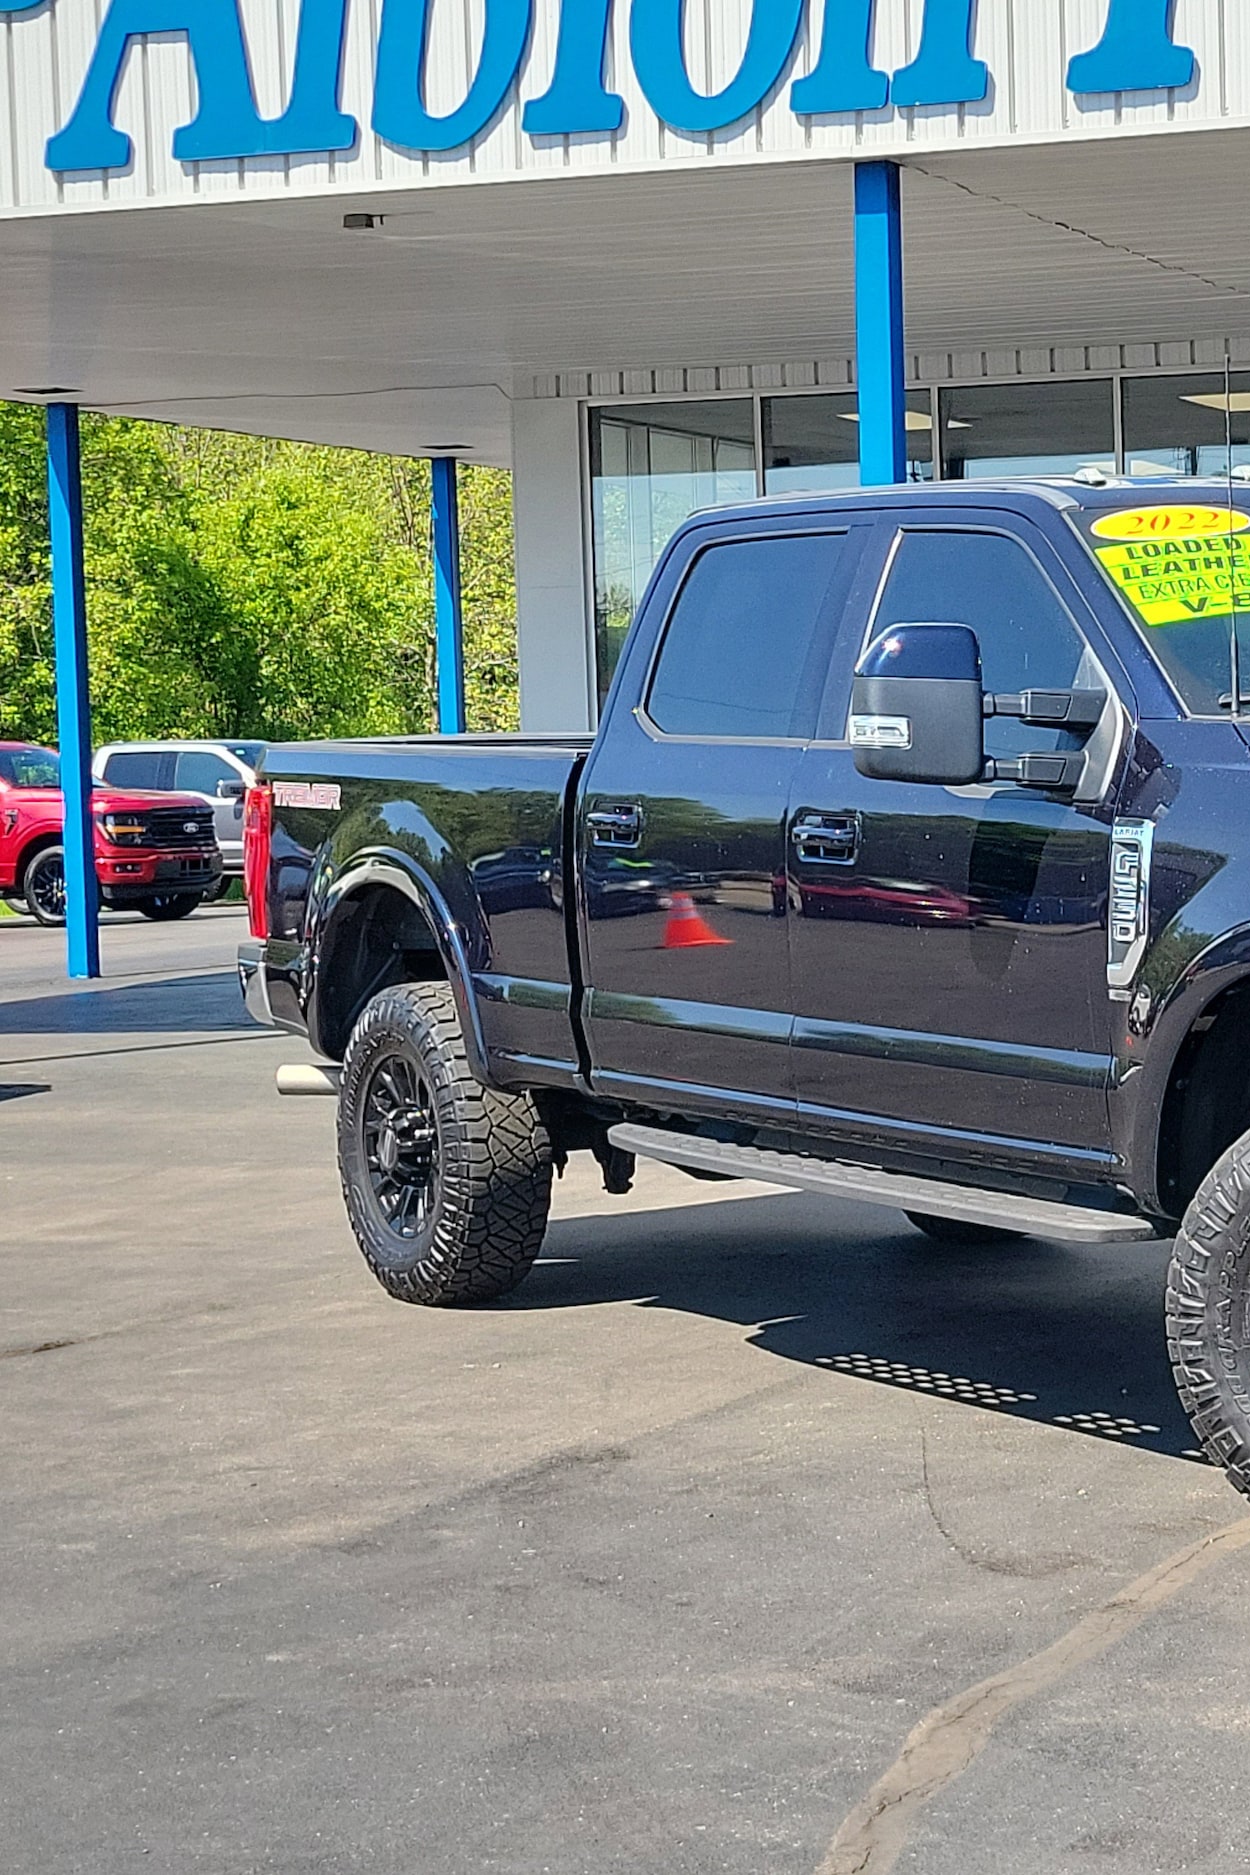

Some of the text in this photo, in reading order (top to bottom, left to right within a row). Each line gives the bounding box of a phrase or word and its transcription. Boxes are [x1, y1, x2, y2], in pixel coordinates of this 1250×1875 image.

[1126, 512, 1220, 534] 2022
[1127, 537, 1242, 560] LOADED
[1139, 577, 1210, 599] EXTRA
[1114, 828, 1144, 837] LARIAT
